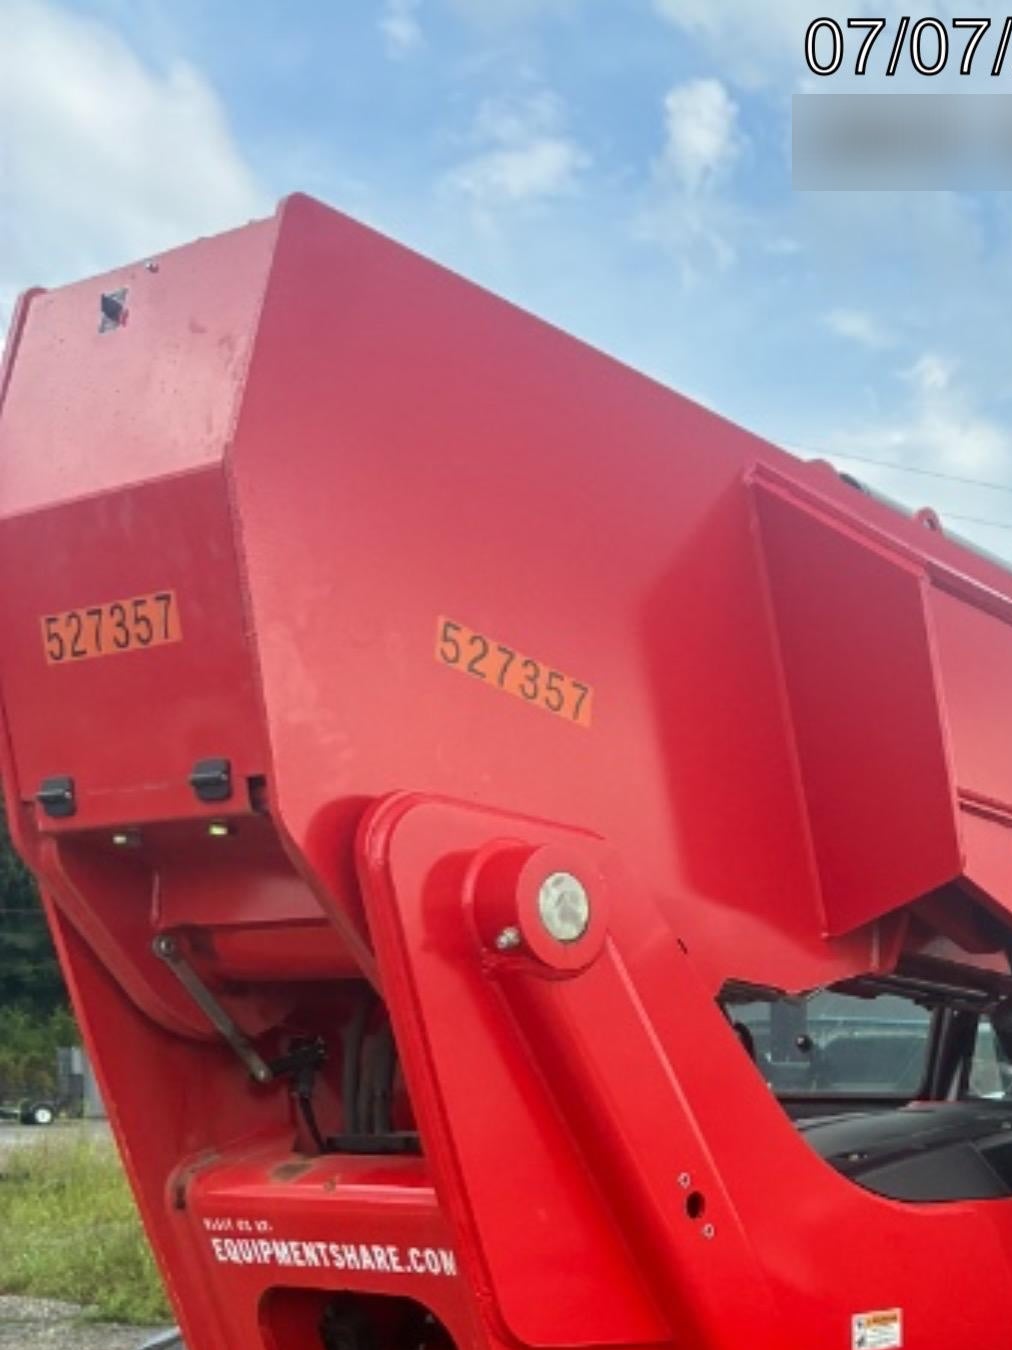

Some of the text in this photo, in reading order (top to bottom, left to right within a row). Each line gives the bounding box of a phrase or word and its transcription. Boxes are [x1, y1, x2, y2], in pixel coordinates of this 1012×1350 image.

[44, 593, 174, 661] 527357
[438, 620, 590, 722] 527357
[210, 1237, 457, 1276] EQUIPMENTSHARE.COM
